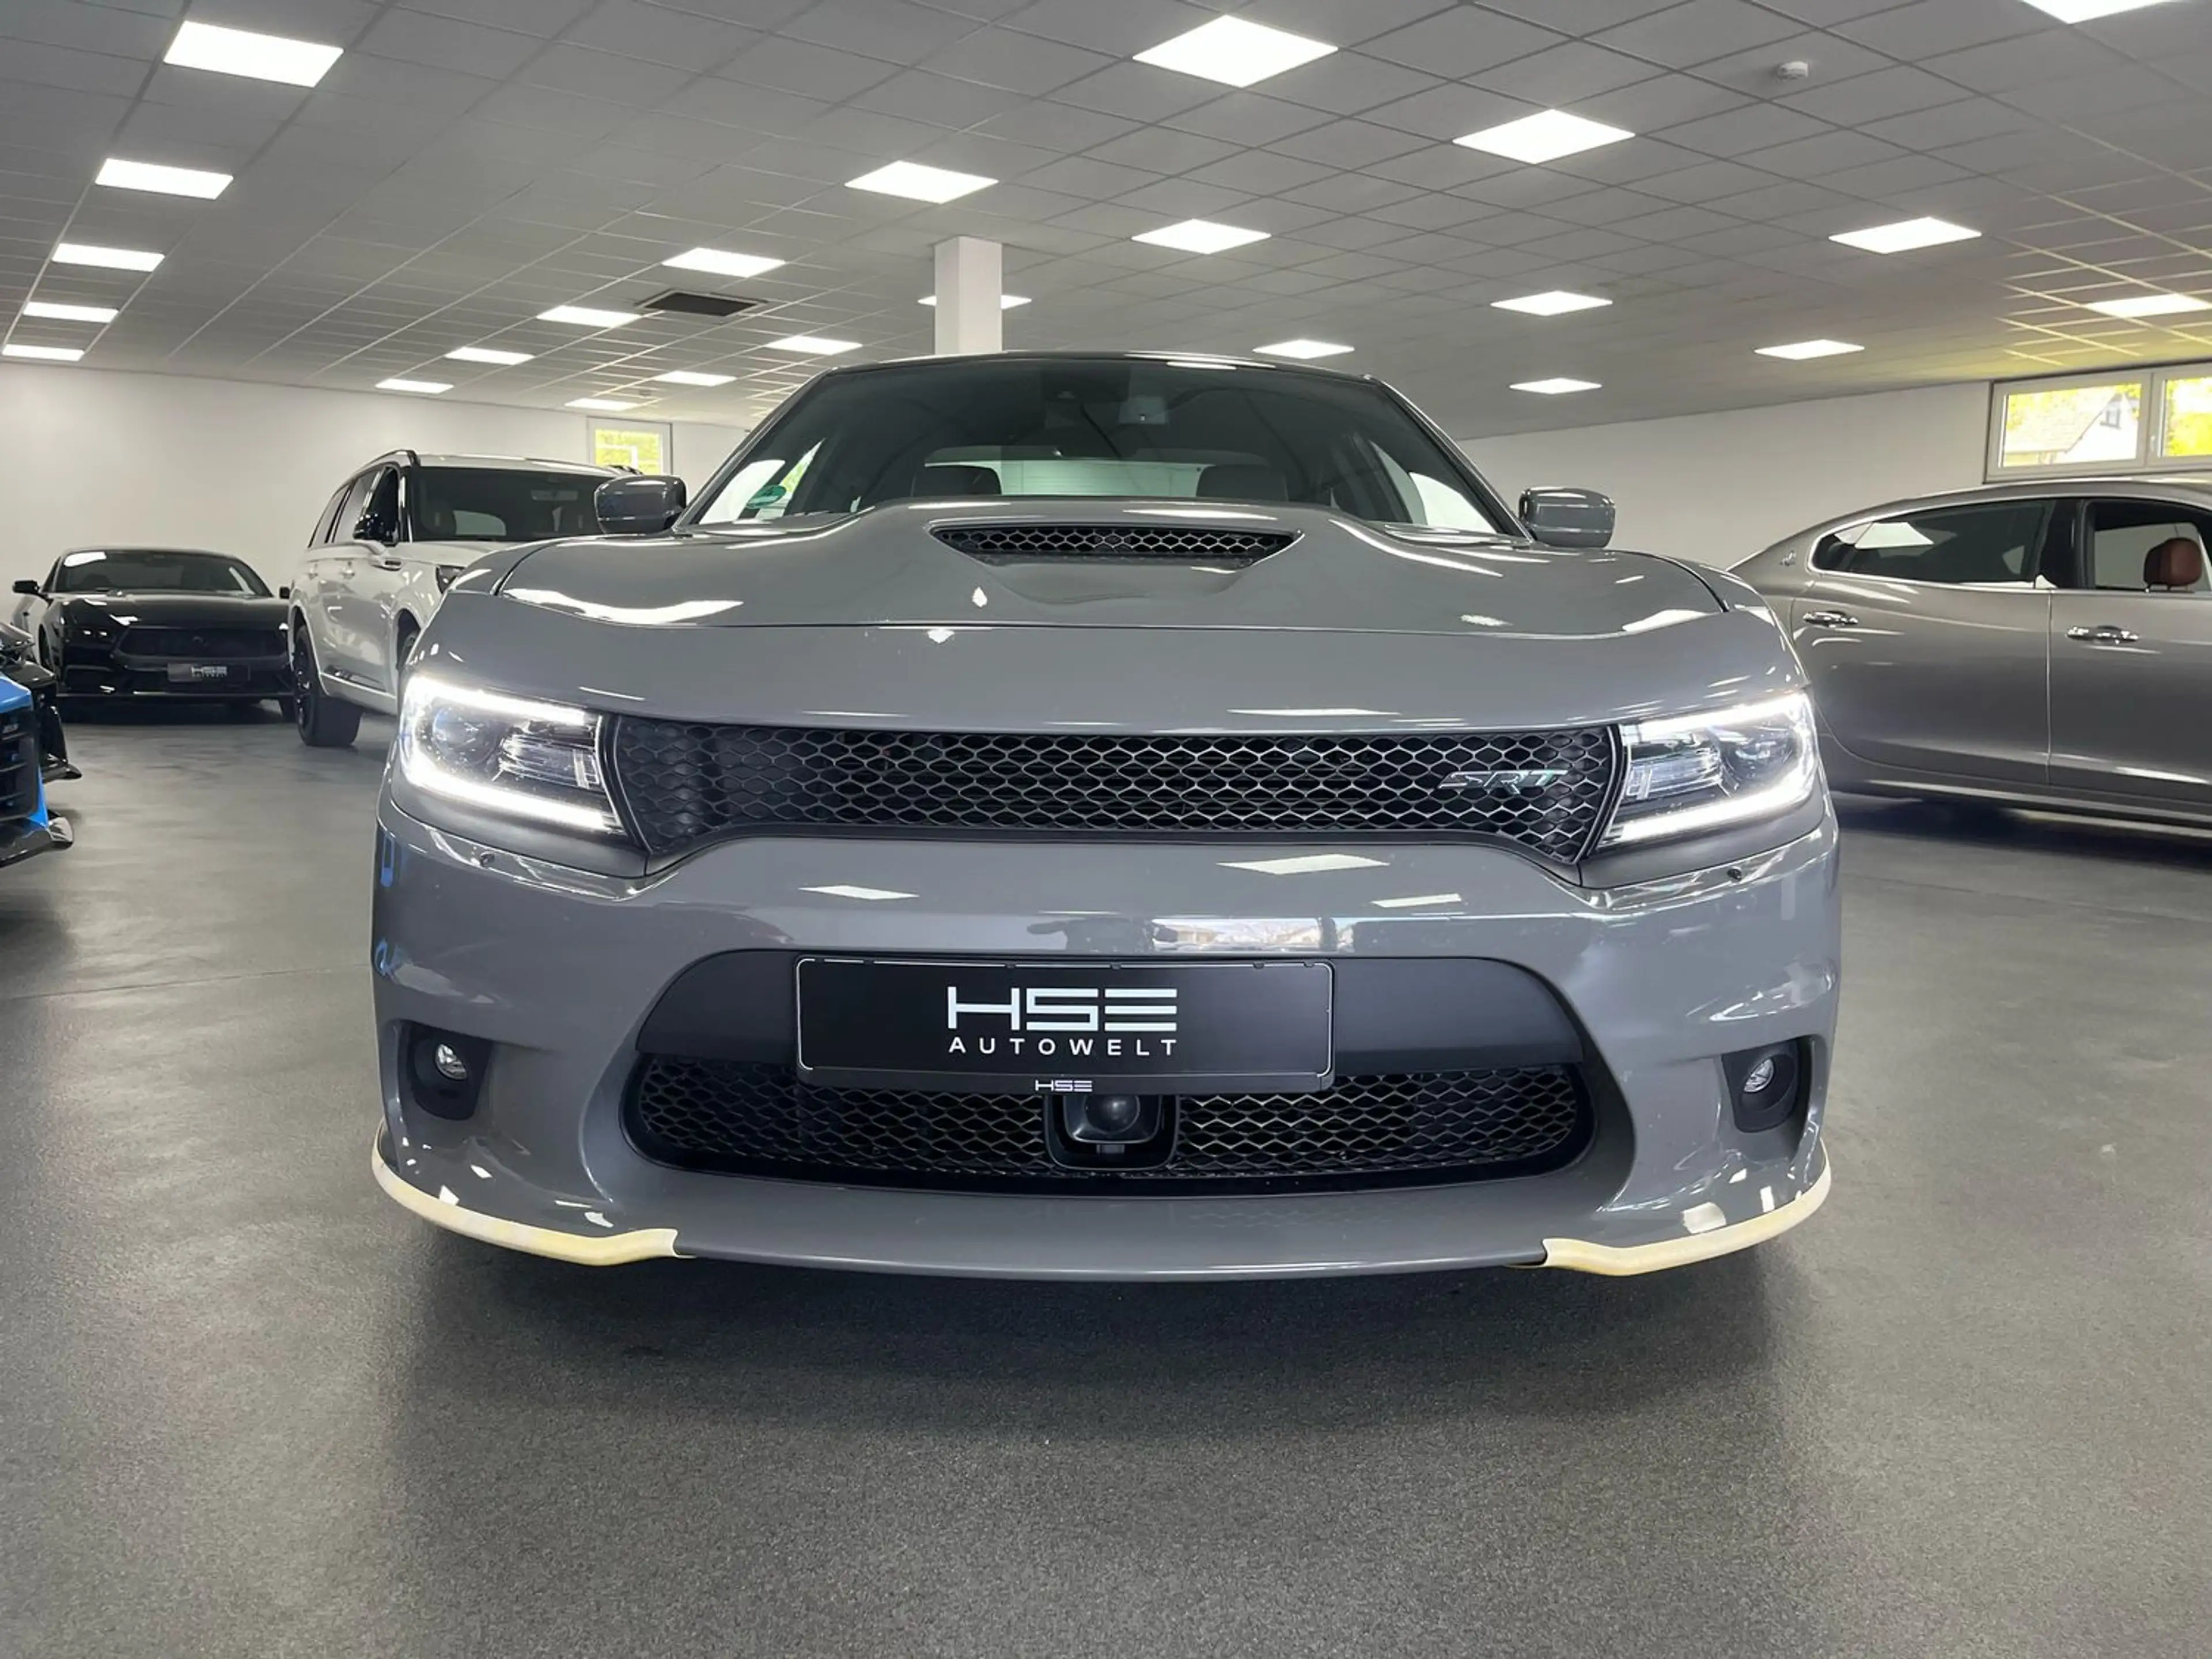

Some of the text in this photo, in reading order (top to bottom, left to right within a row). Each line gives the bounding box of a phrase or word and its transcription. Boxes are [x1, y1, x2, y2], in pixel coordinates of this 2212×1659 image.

[948, 986, 1177, 1031] HSE
[949, 1036, 1177, 1055] AUTOWELT
[1035, 1080, 1092, 1092] HSE
